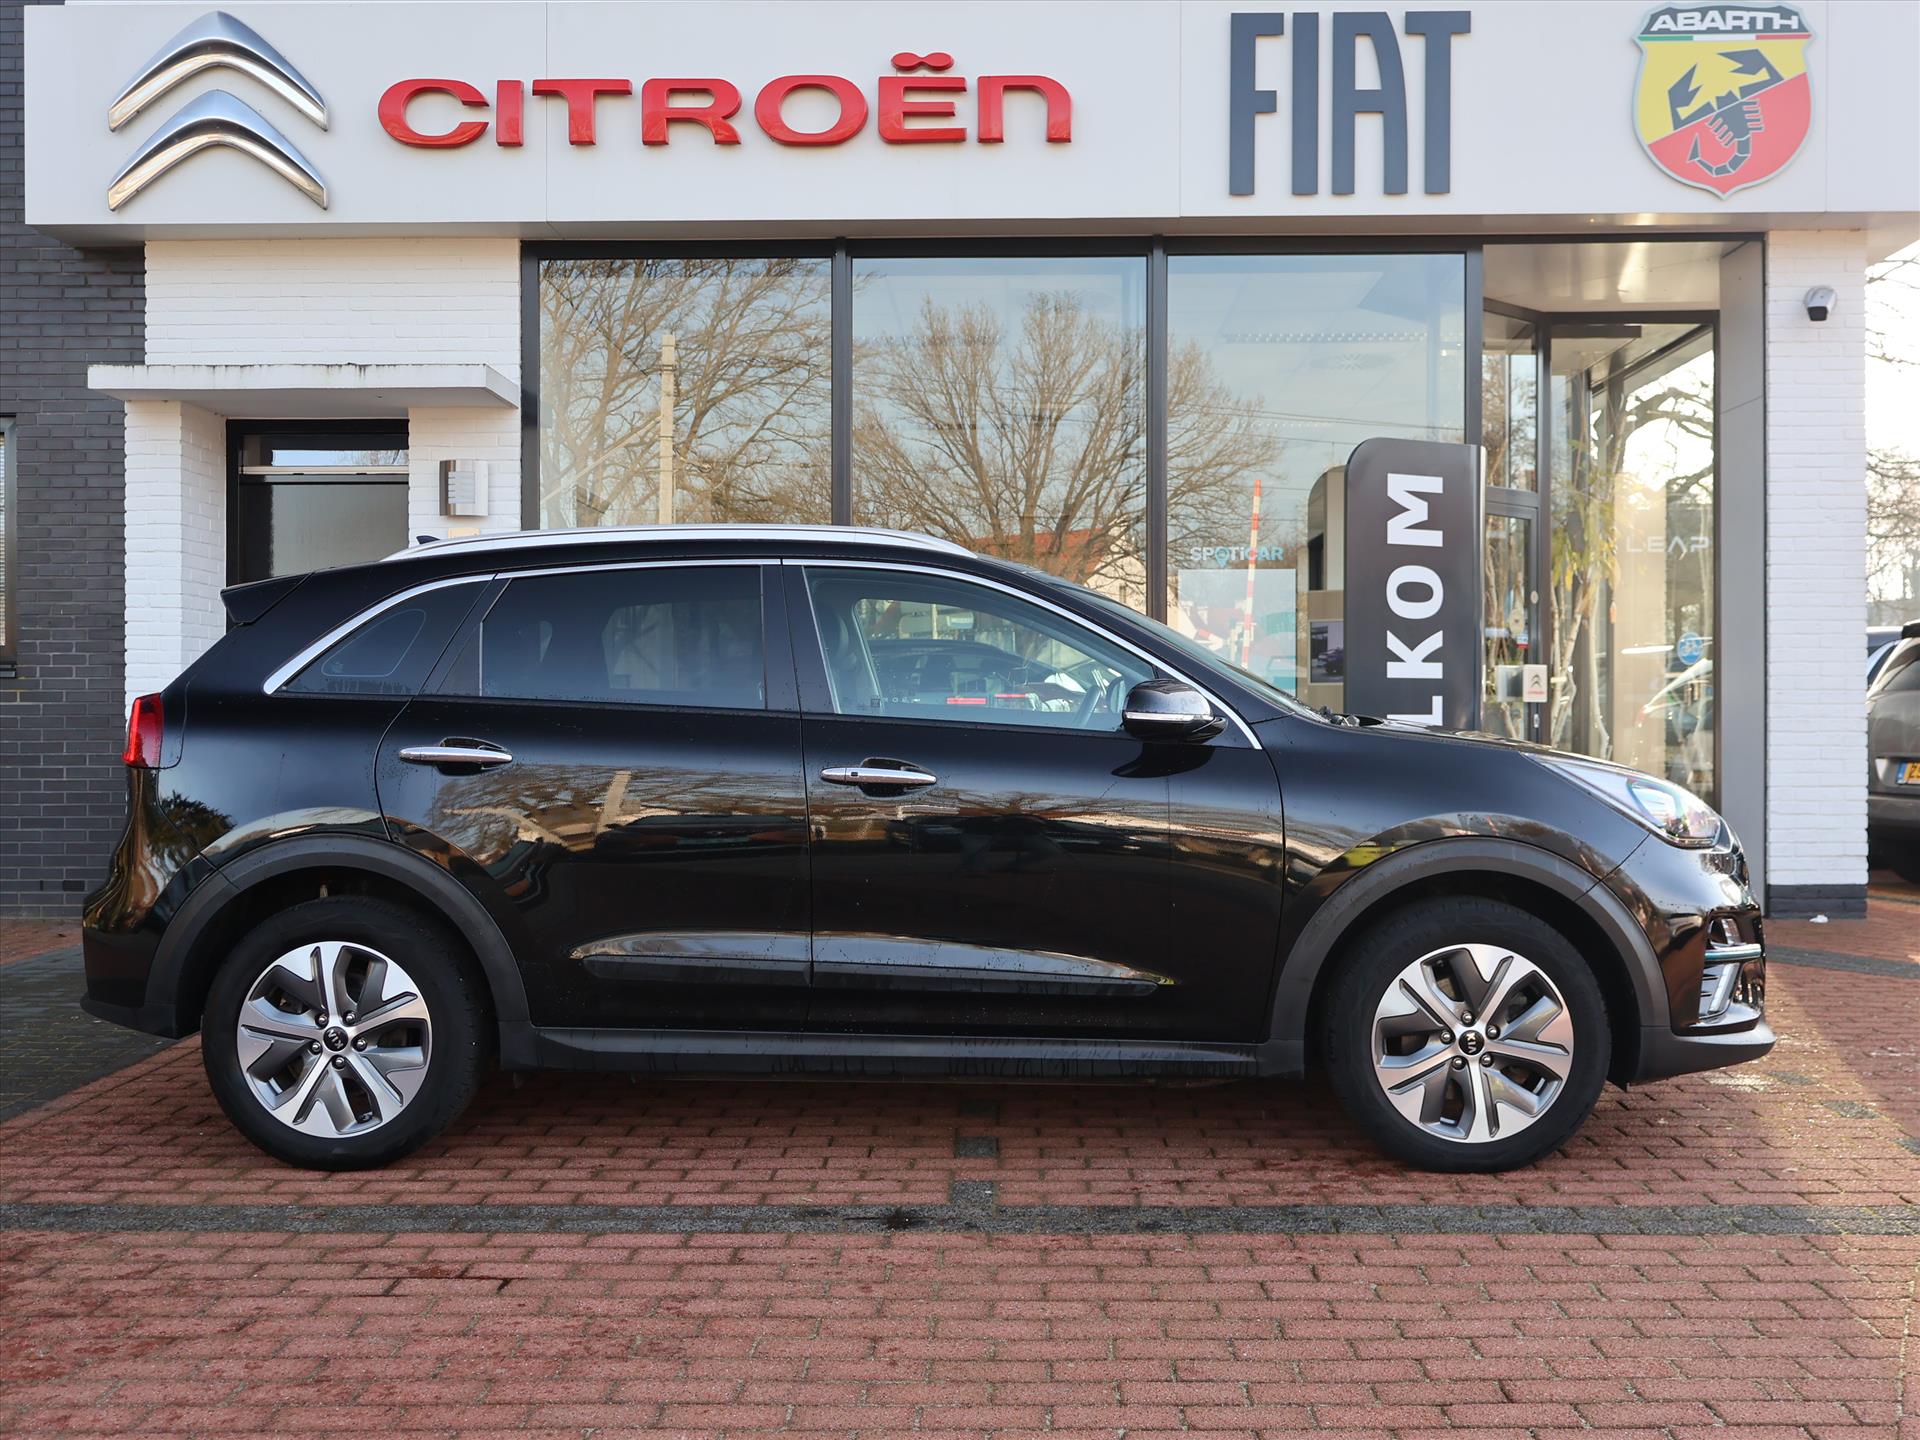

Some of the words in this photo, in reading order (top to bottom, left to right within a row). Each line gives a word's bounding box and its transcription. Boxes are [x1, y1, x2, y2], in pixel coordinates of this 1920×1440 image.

[1650, 10, 1799, 31] ABARTH
[378, 52, 1072, 147] CITROËN
[1229, 11, 1471, 195] FIAT
